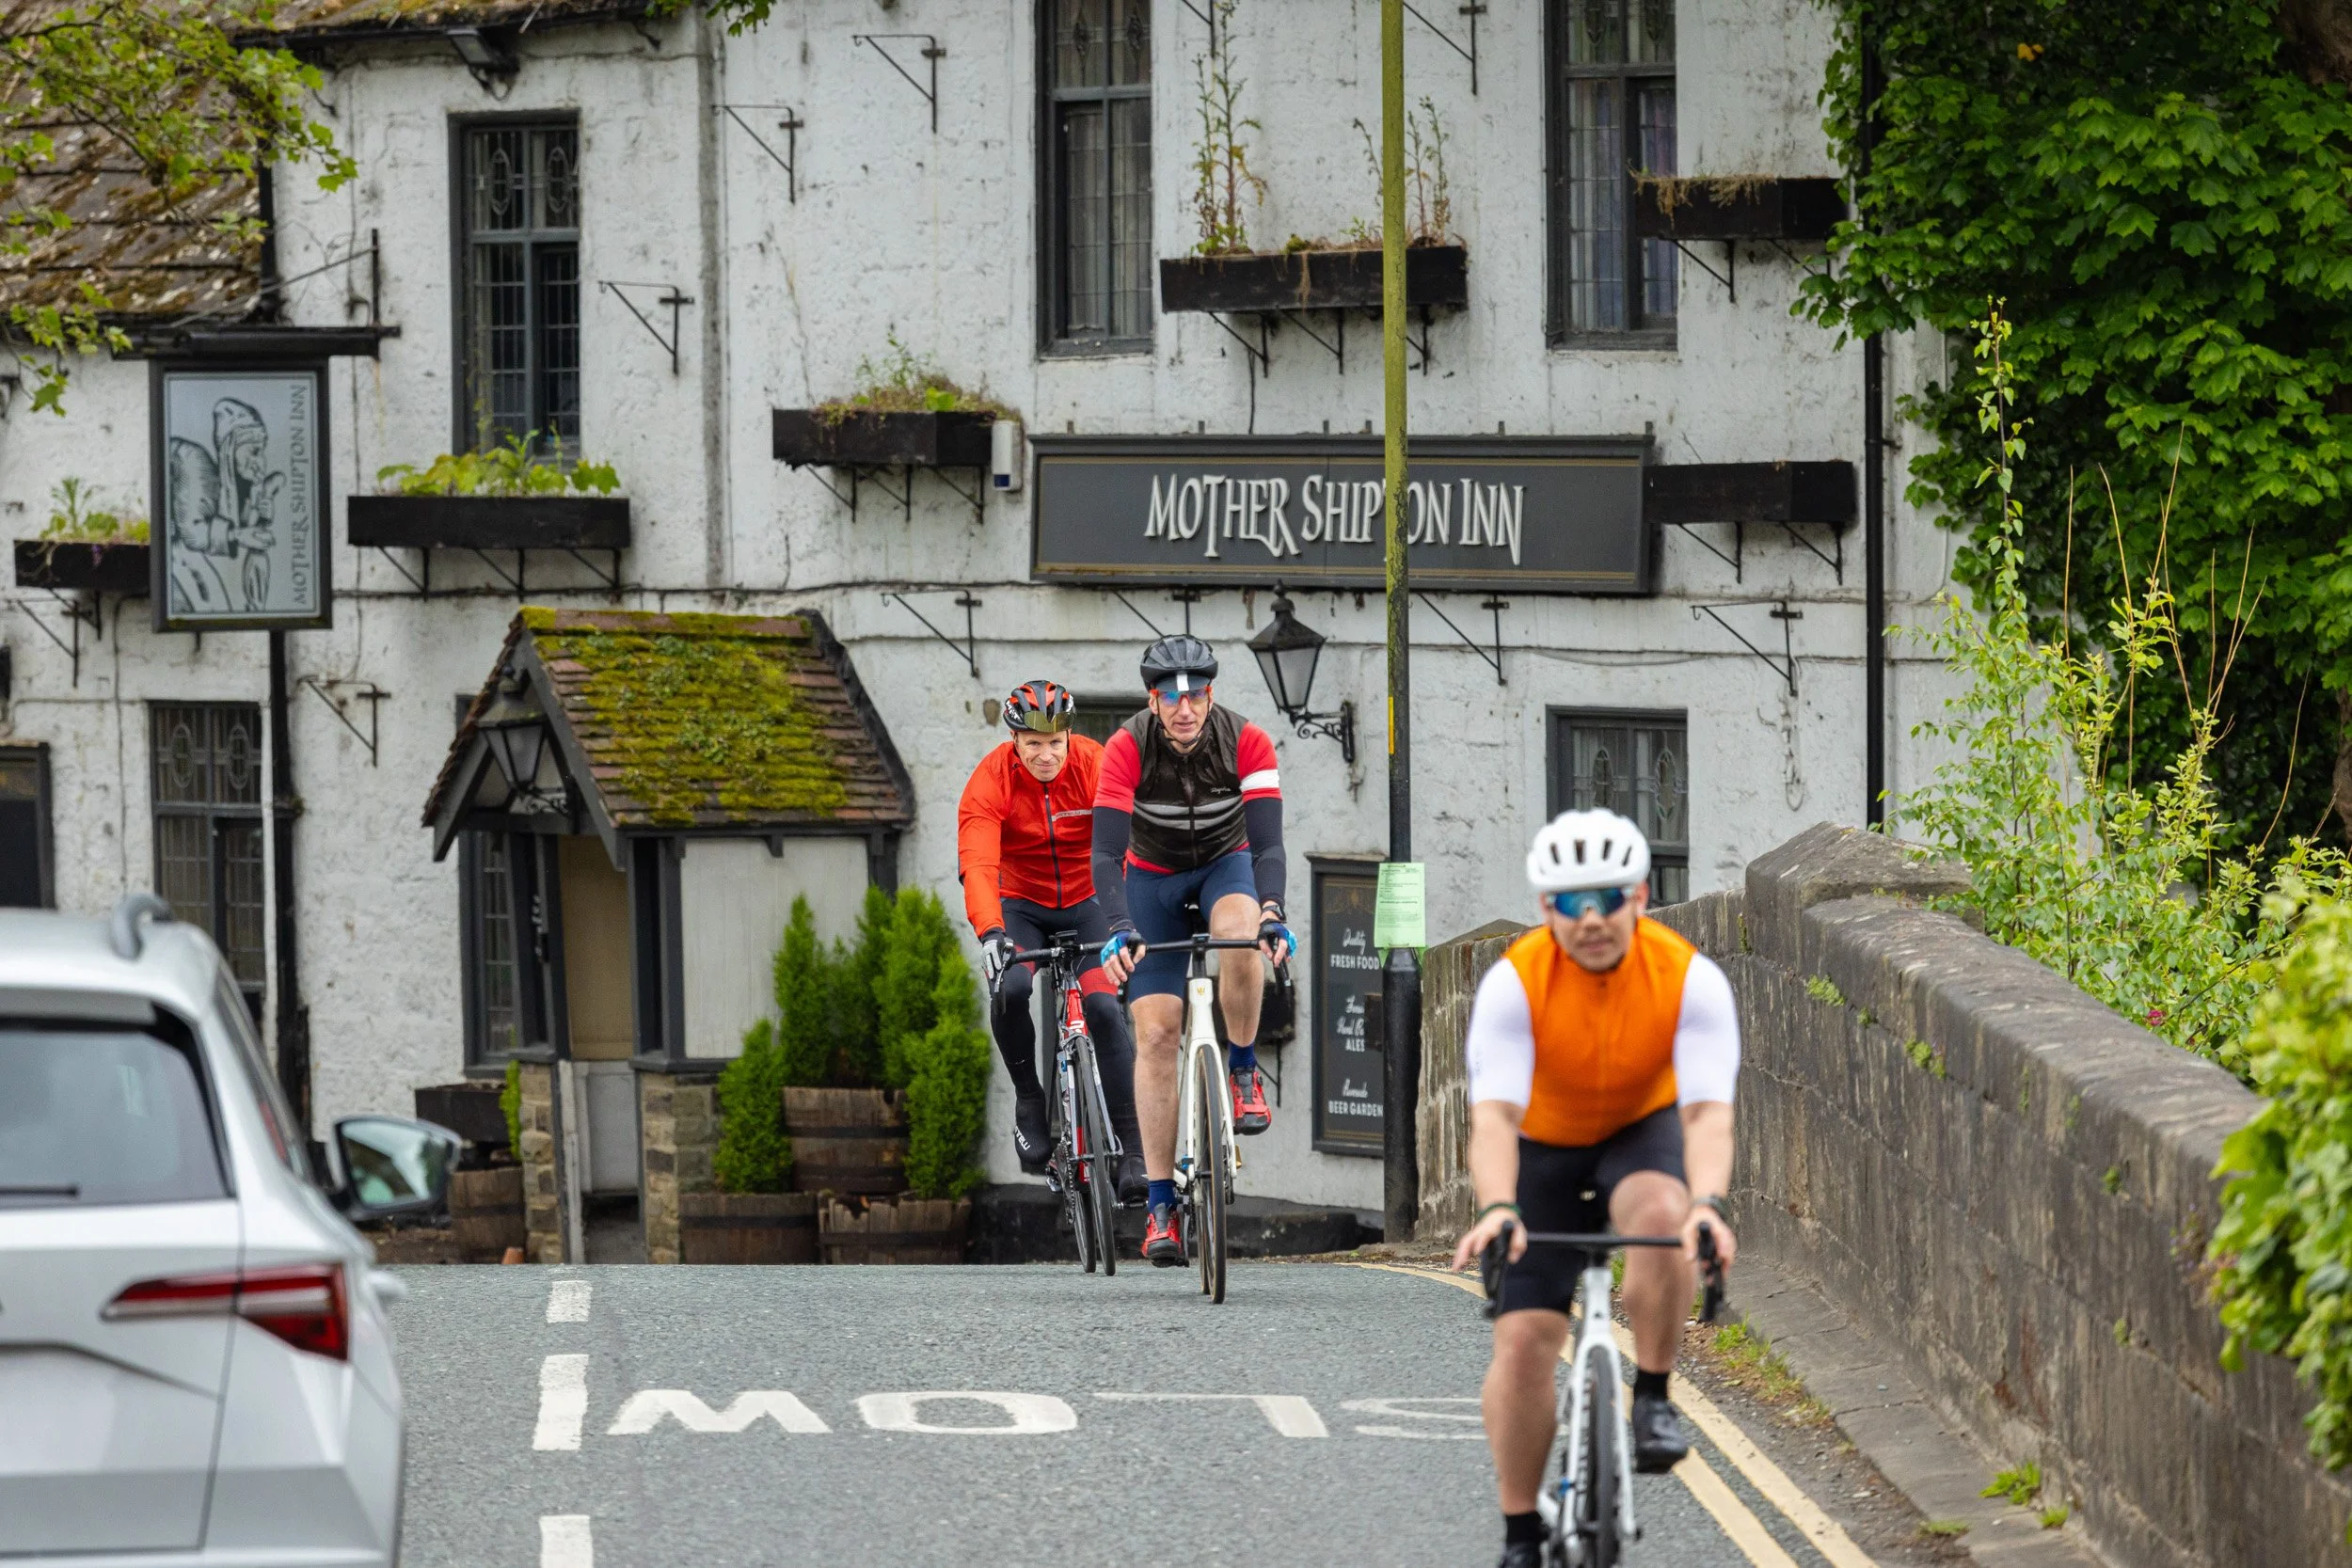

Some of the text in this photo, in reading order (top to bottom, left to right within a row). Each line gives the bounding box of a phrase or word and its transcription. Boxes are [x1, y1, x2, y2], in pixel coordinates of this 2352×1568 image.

[289, 384, 310, 605] MOTHER SHIPTON INN
[1143, 472, 1524, 565] MOTHER SHIPON INN
[1330, 954, 1380, 970] FRESH FOOD
[1327, 1101, 1384, 1117] BEER GARDEN
